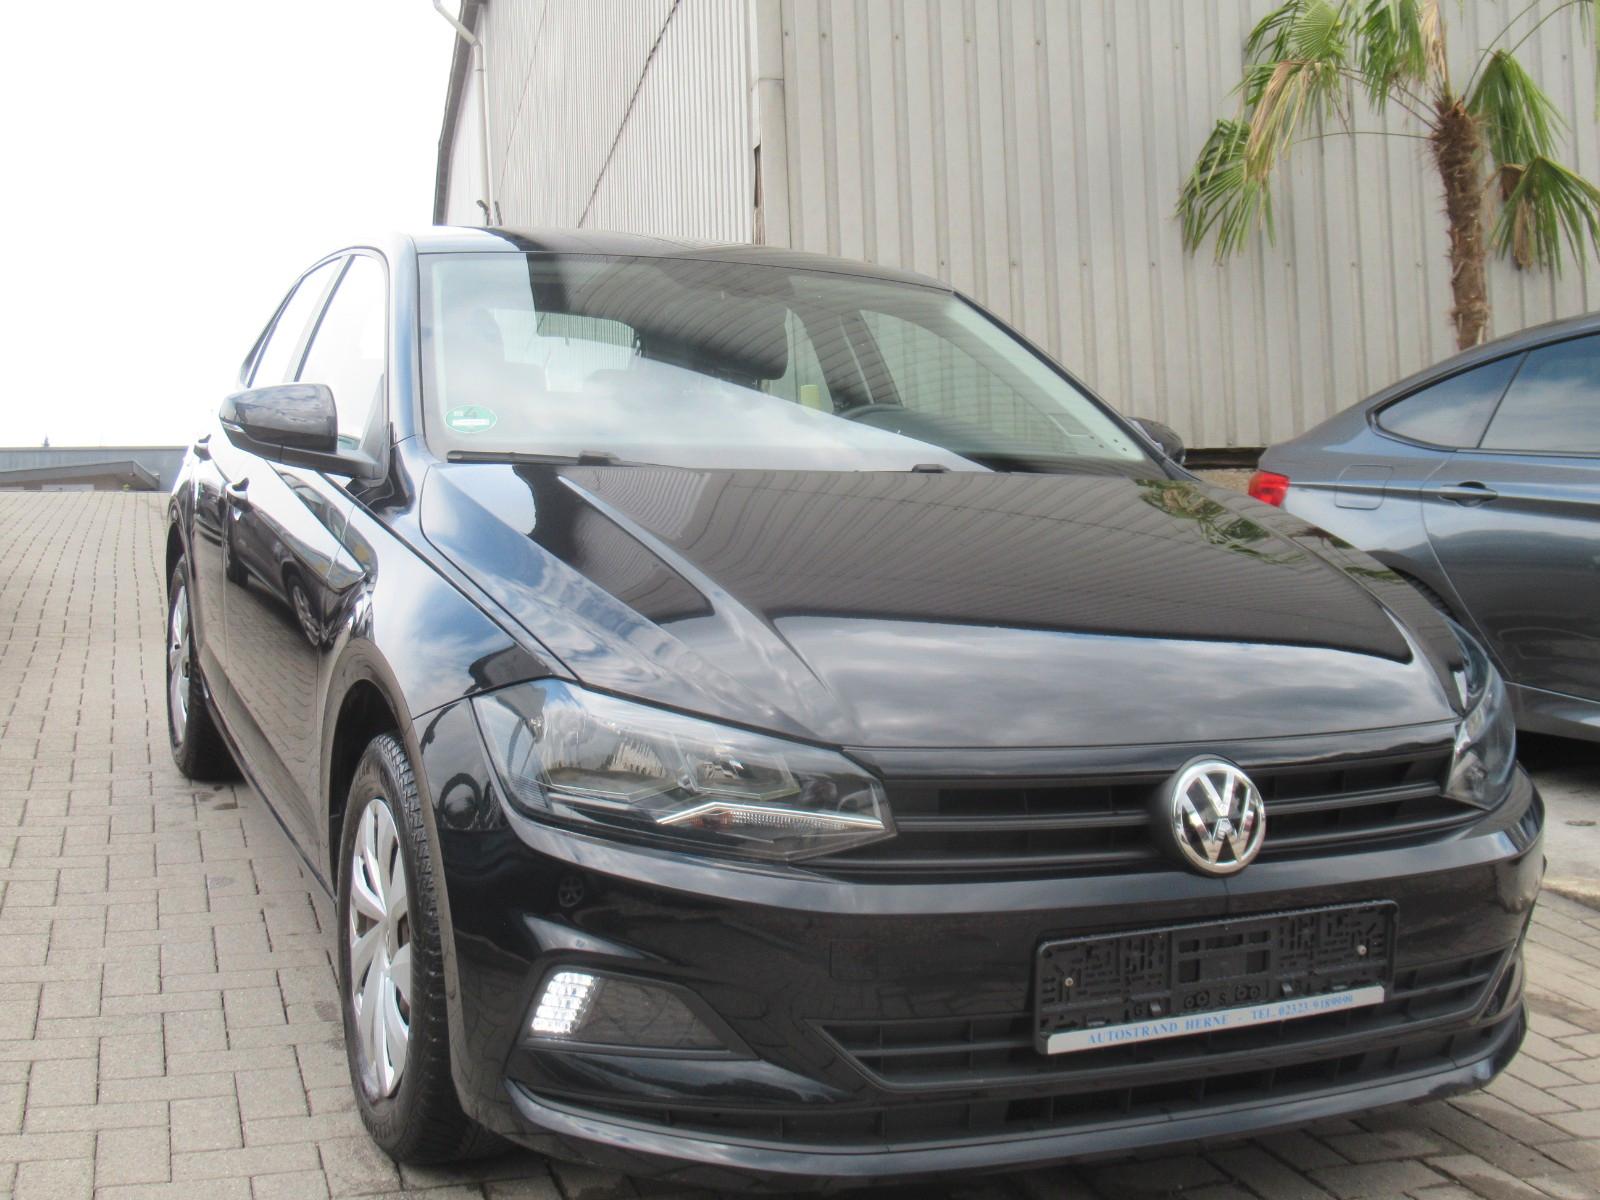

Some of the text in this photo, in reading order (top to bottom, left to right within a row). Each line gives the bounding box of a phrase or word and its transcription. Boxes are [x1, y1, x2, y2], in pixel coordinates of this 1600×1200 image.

[1177, 767, 1260, 868] VW
[1087, 1022, 1178, 1044] AUTOSTRAND
[1184, 1014, 1230, 1031] HERNE
